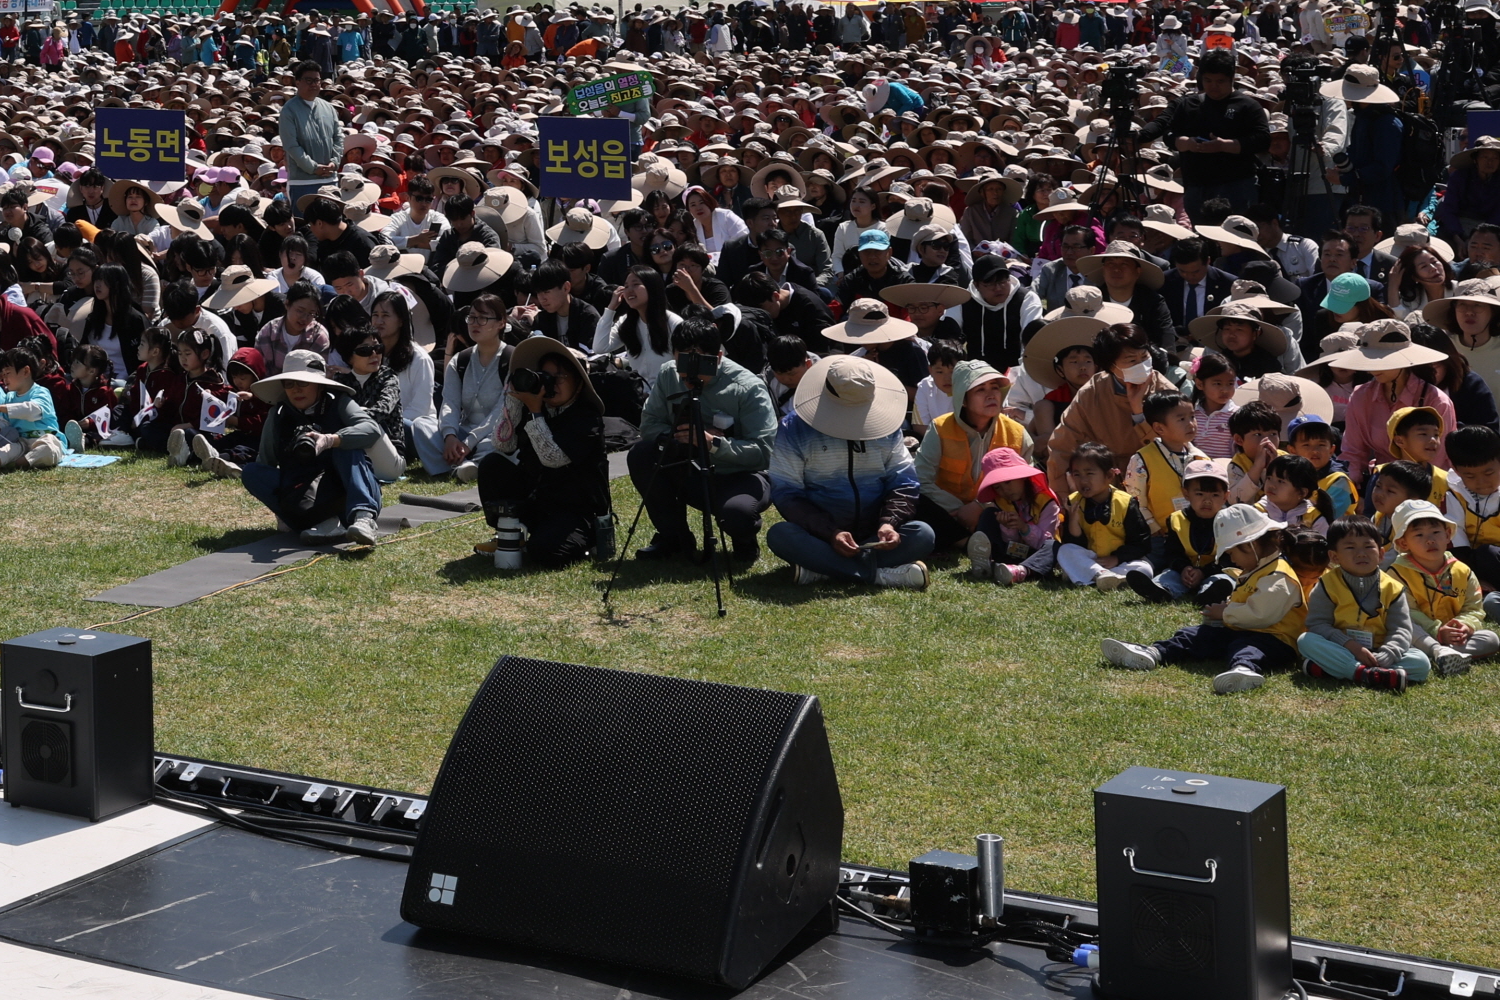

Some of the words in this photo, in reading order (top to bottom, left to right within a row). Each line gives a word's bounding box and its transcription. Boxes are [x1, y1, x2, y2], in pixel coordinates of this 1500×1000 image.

[574, 80, 616, 99] 보성읍의
[578, 95, 608, 112] 오늘도
[610, 87, 642, 104] 최고조
[100, 127, 180, 163] 노동면
[545, 139, 628, 179] 보성읍
